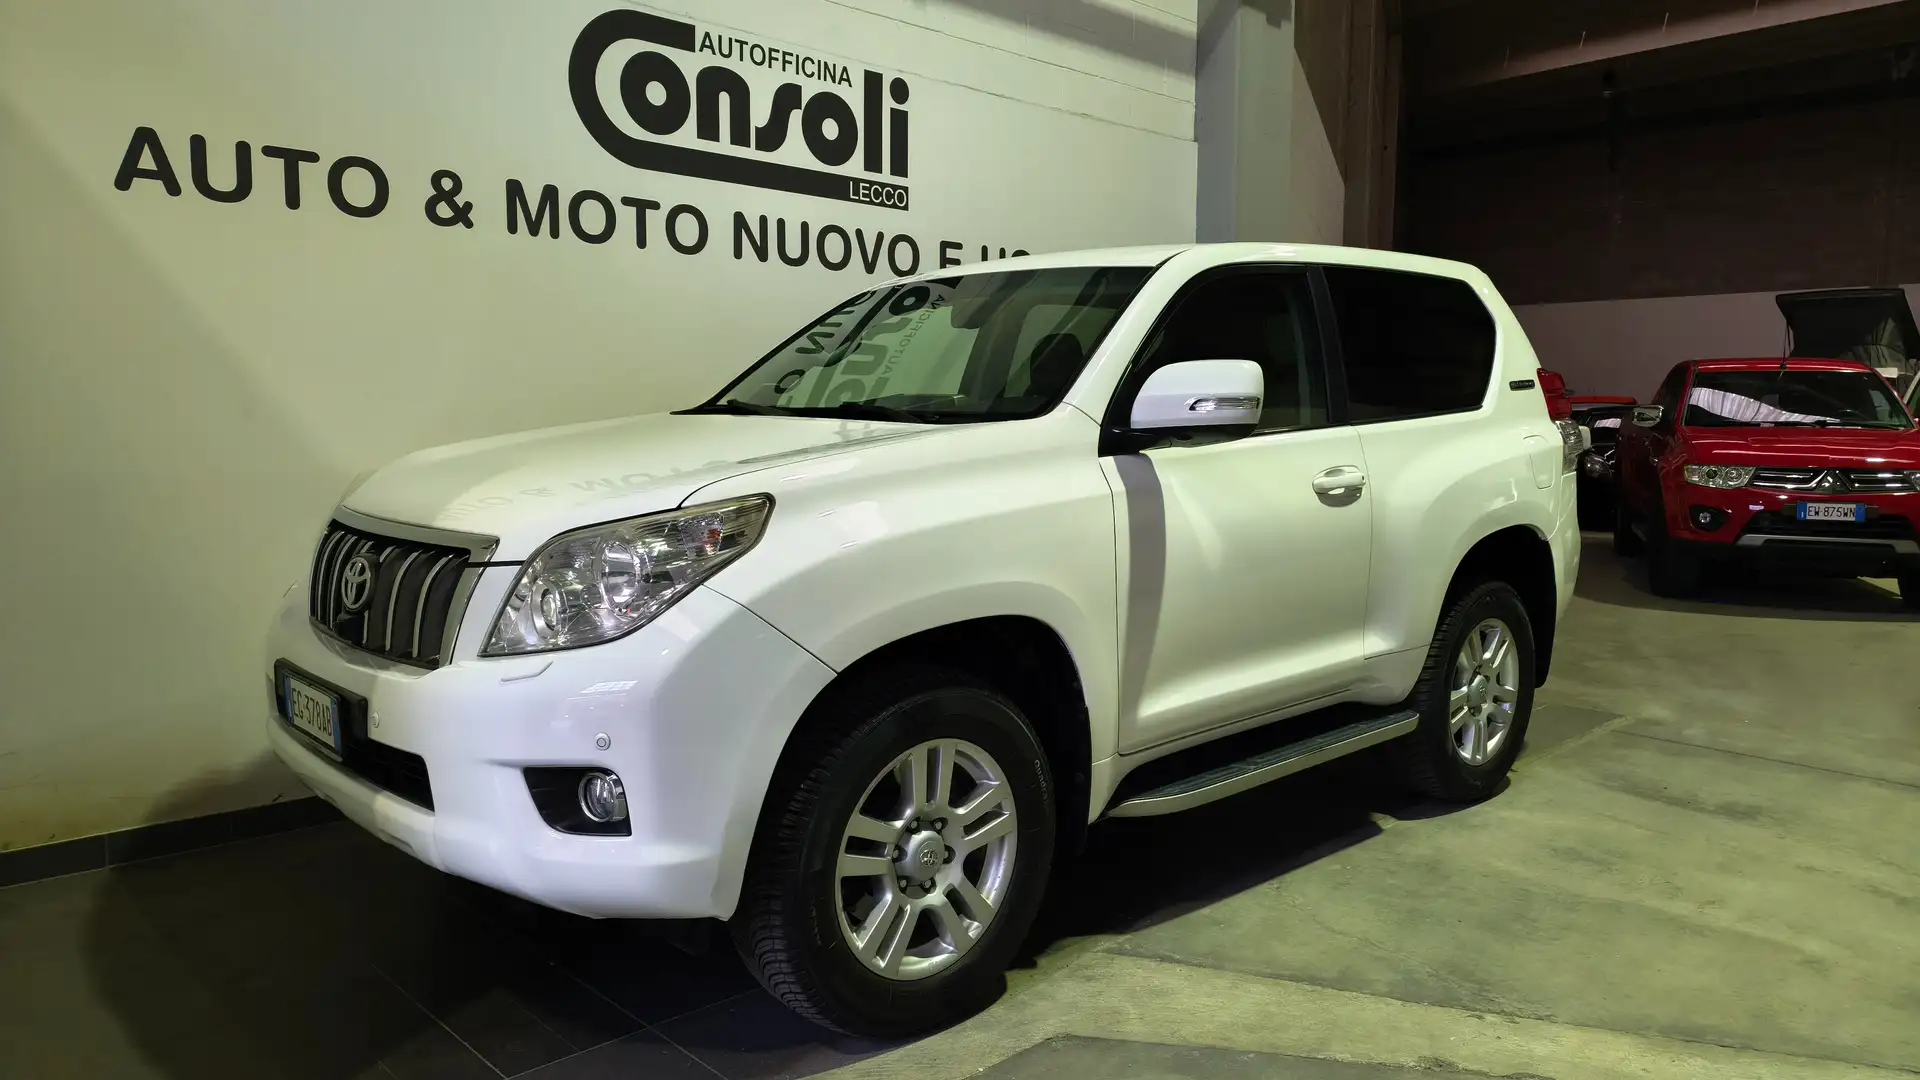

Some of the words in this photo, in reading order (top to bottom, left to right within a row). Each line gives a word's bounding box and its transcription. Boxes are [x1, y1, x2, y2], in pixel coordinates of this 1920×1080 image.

[698, 31, 853, 88] AUTOFFICINA
[113, 126, 390, 218] AUTO
[425, 169, 474, 230] &
[505, 178, 709, 256] MOTO
[733, 211, 920, 277] NUOVO
[849, 181, 907, 207] LECCO
